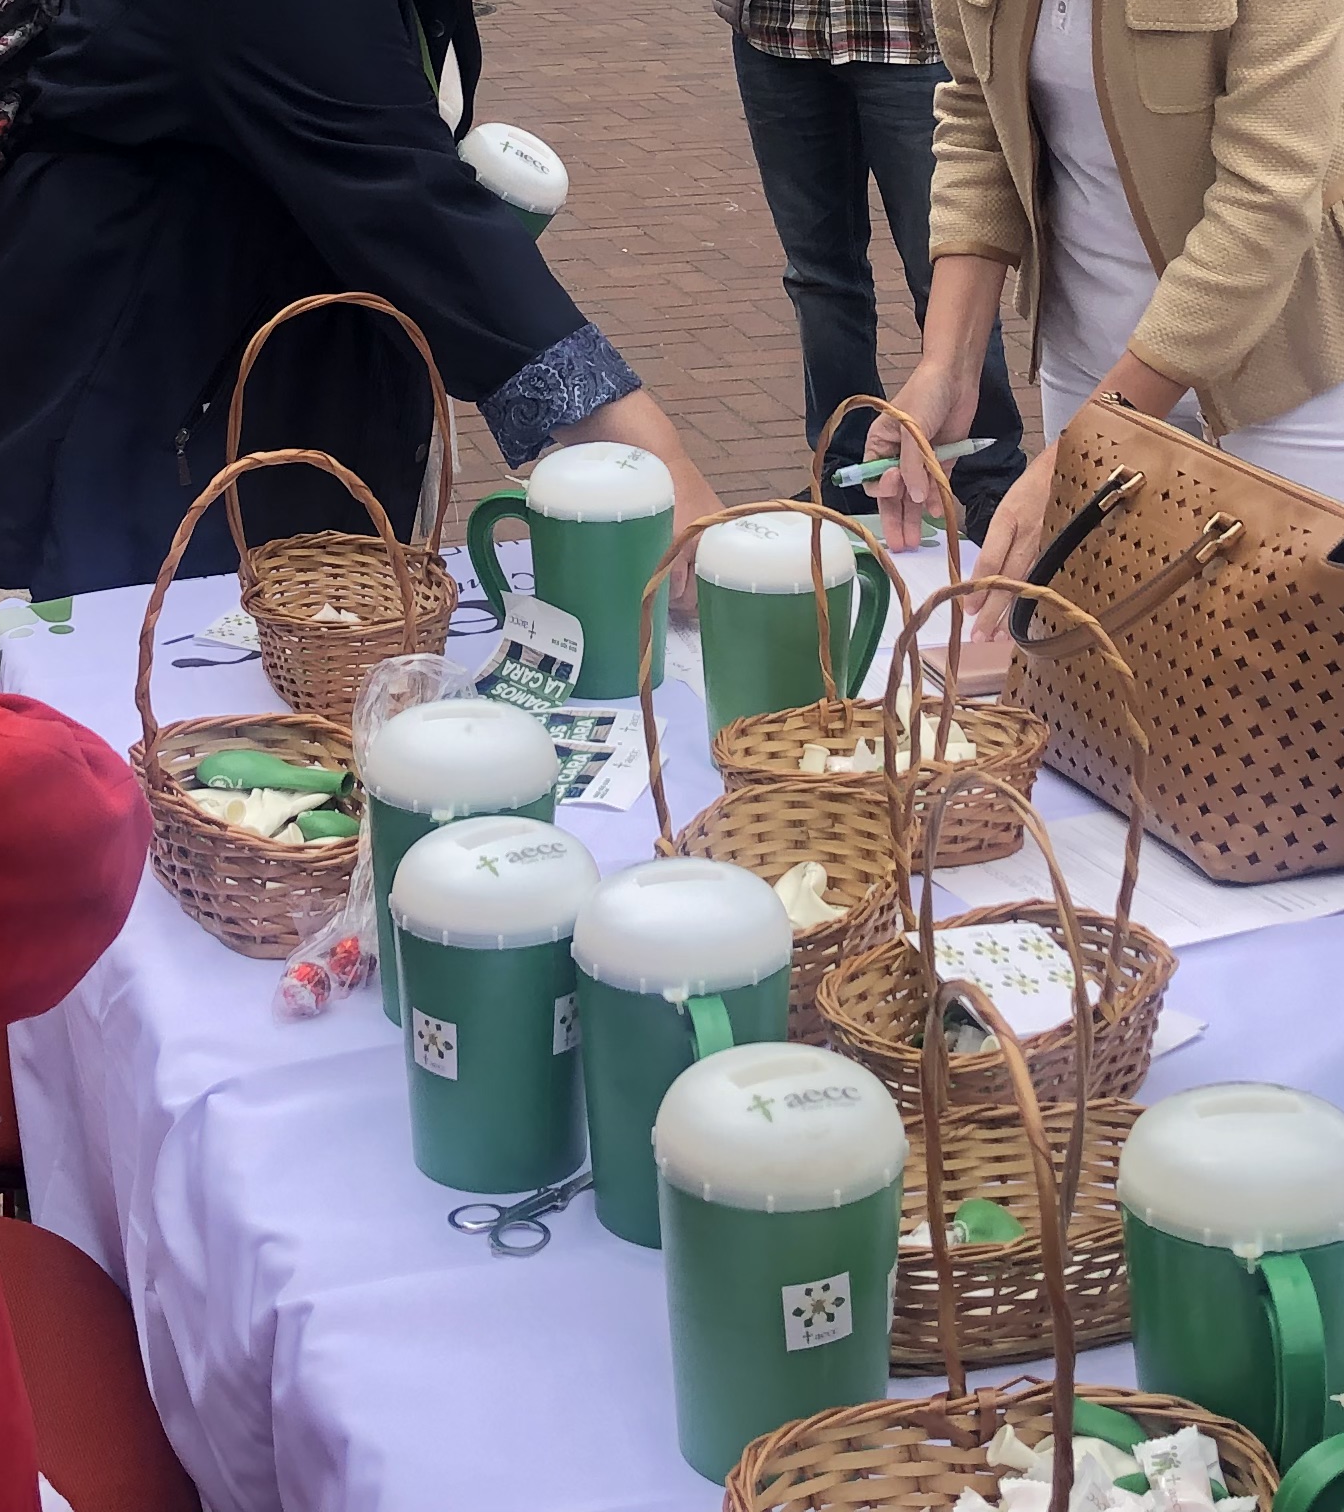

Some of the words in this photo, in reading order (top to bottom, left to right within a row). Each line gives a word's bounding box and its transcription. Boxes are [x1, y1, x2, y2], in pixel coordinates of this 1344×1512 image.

[515, 149, 550, 175] aecc
[501, 659, 544, 688] CARA
[491, 682, 551, 712] DAMOS
[543, 678, 567, 698] LA
[558, 753, 592, 783] CARA
[505, 842, 567, 864] aecc
[783, 1087, 862, 1109] aecc
